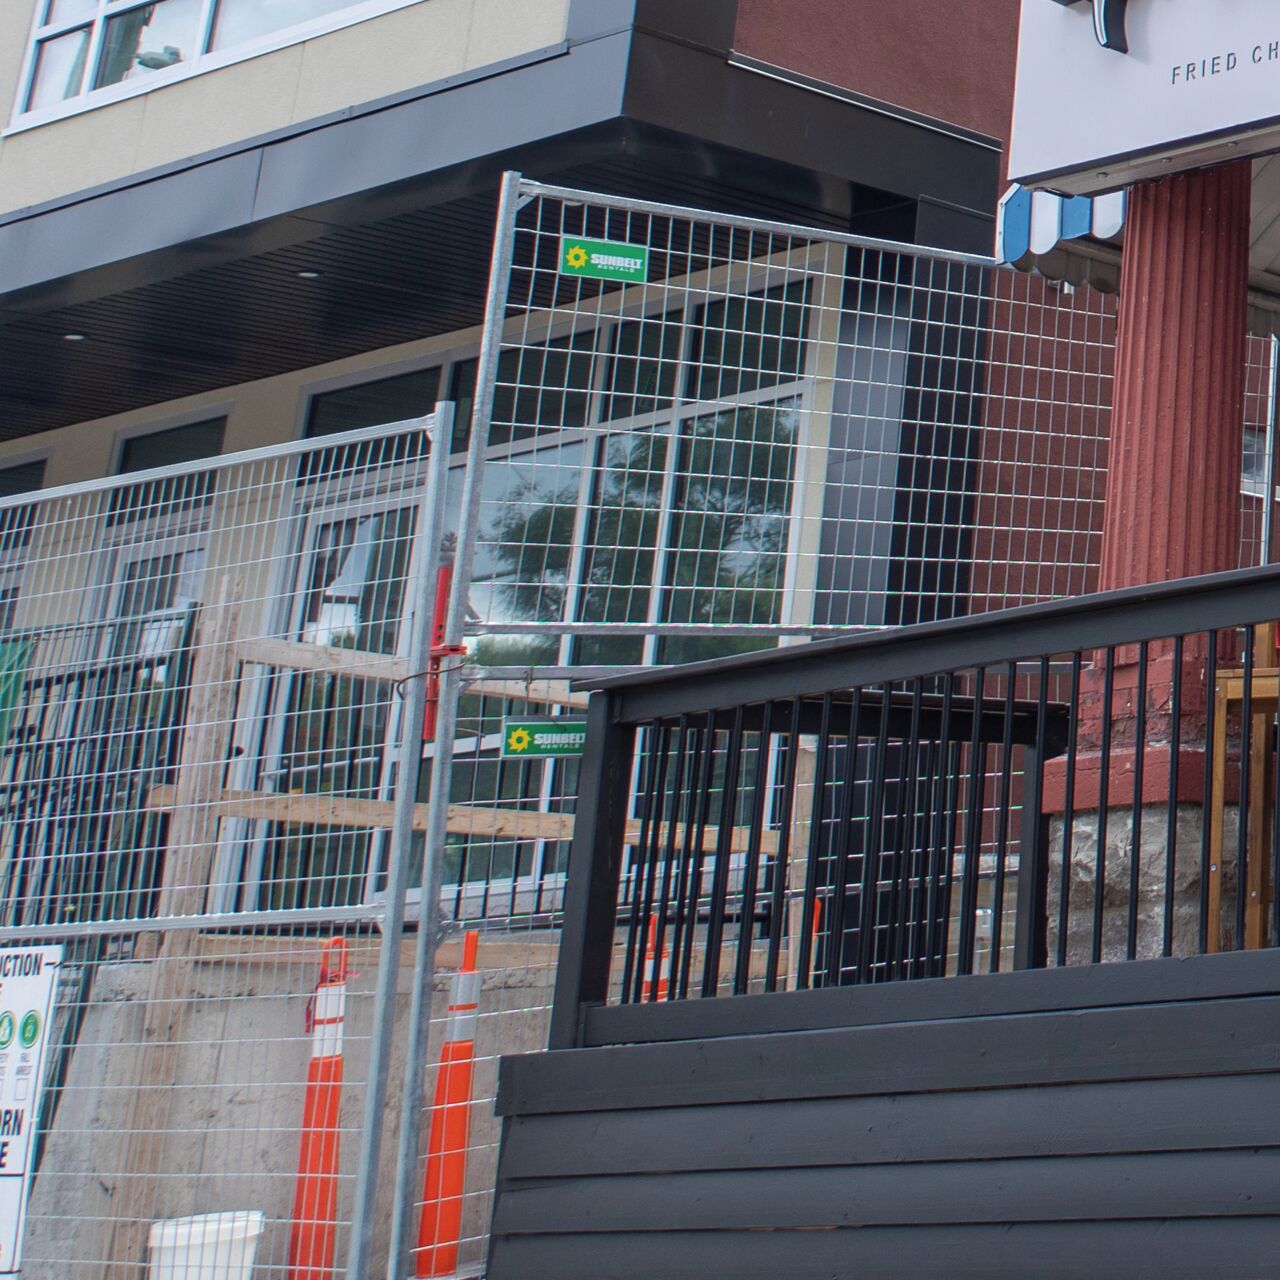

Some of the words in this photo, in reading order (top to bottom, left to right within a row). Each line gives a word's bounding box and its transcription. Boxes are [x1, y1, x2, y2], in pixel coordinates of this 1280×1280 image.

[1172, 52, 1237, 84] FRIED
[591, 253, 643, 269] SUNBELT
[597, 265, 635, 273] RENTALS
